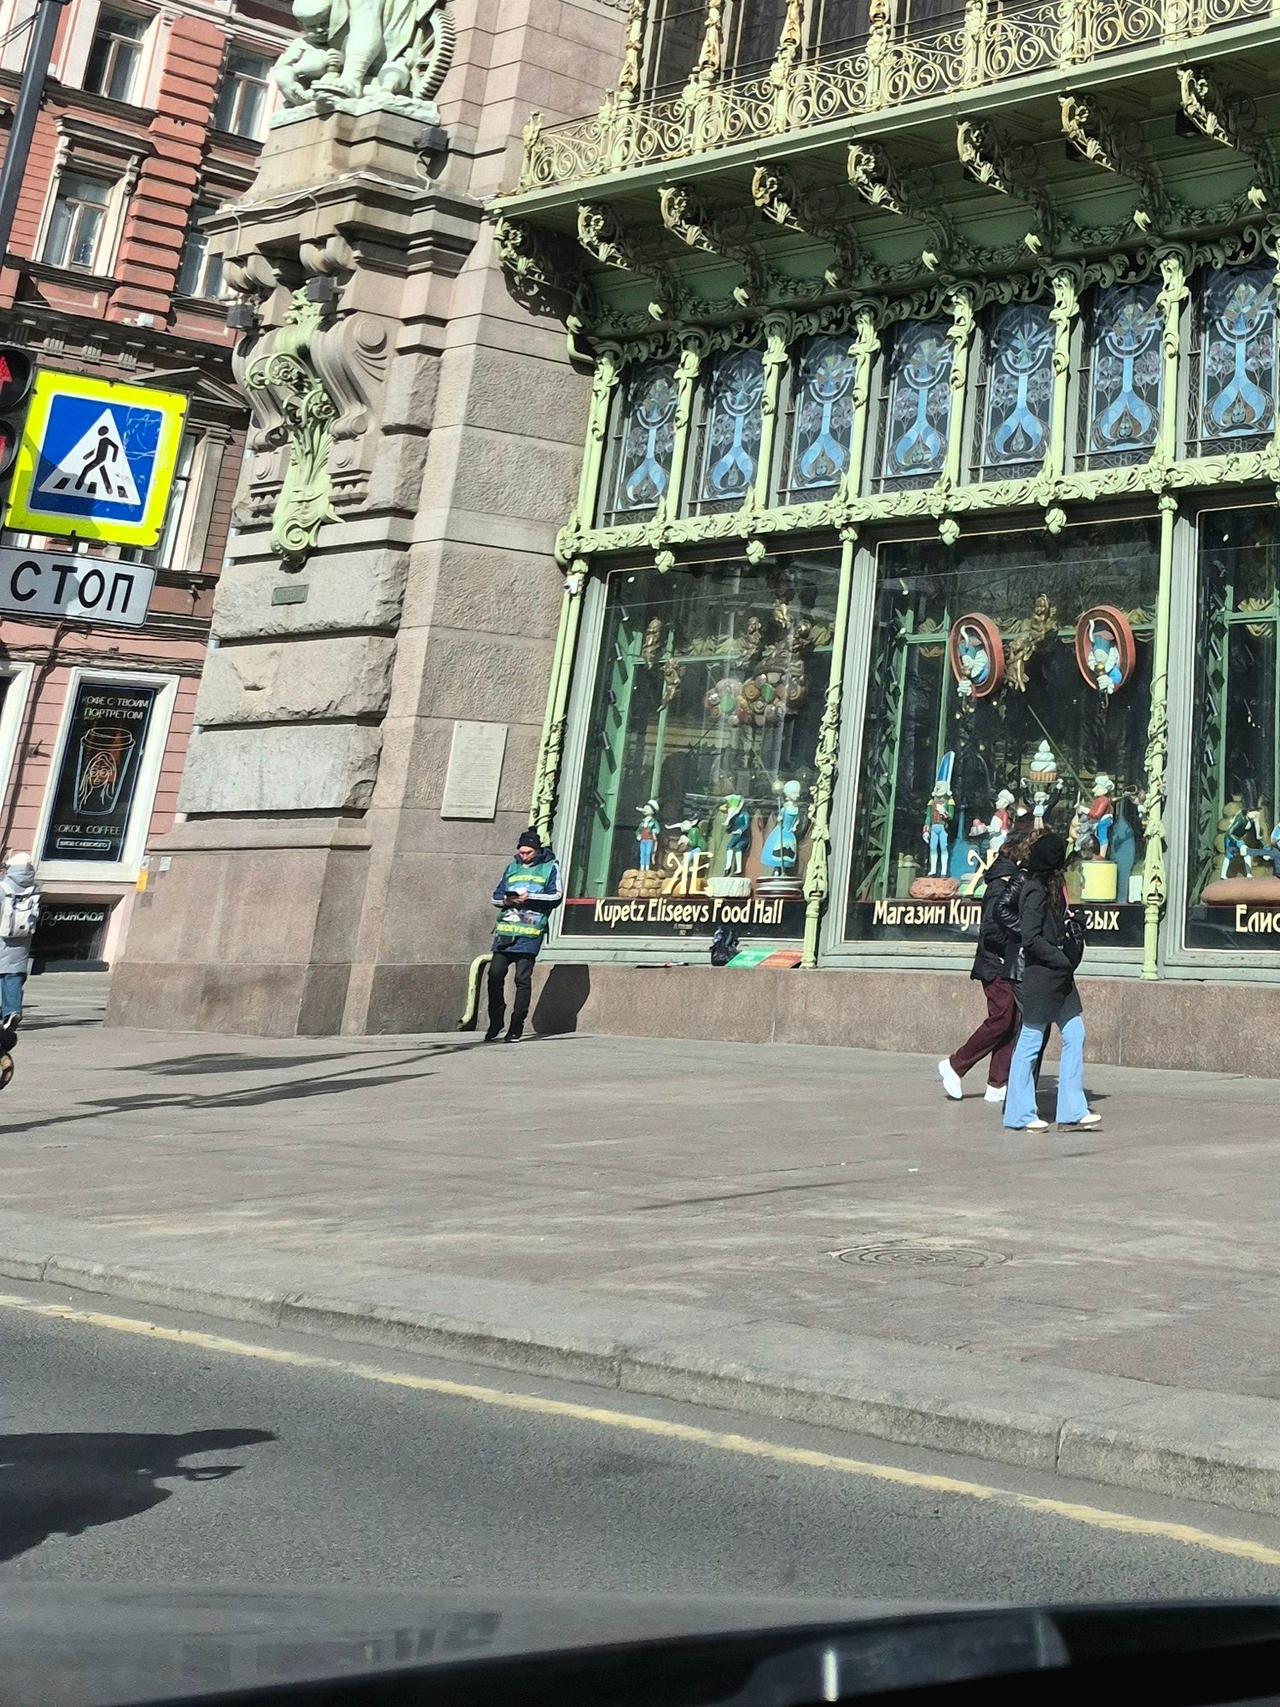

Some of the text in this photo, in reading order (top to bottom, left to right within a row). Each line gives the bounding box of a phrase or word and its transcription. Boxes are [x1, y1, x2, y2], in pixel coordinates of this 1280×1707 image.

[10, 560, 135, 614] СТОП
[84, 707, 144, 720] ПОРТРЕТОМ
[86, 825, 121, 835] COFFEE
[594, 898, 785, 928] Kupetz Eliseevs Food Hall
[872, 900, 946, 926] Магазин
[949, 900, 982, 932] Куп
